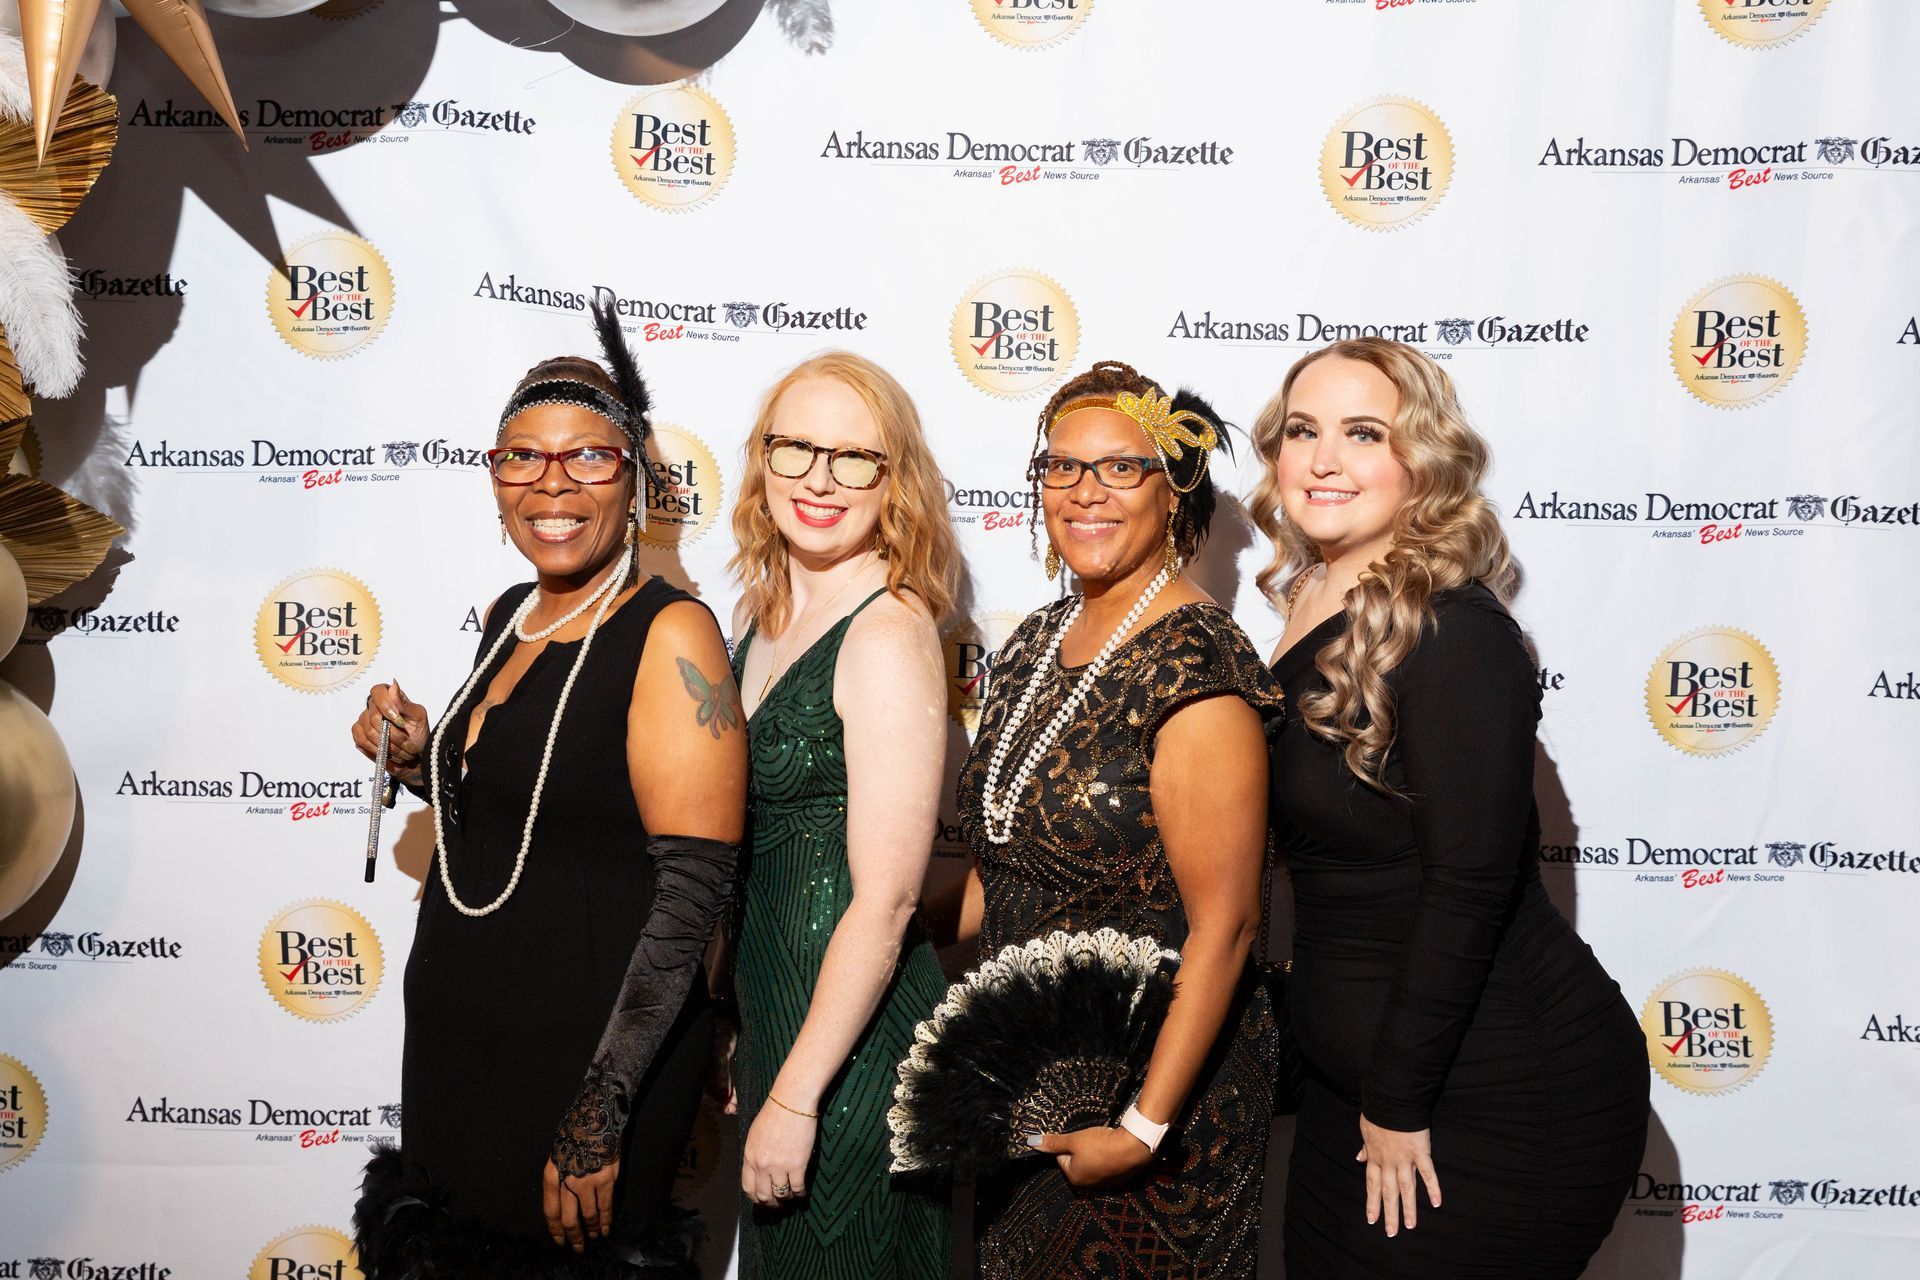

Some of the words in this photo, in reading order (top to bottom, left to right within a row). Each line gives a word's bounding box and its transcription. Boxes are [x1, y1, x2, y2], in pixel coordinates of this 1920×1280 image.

[128, 99, 249, 127] Arkanss
[256, 99, 385, 128] Democrat
[432, 99, 536, 135] Gazette
[309, 130, 350, 150] Best
[354, 135, 377, 143] News
[379, 134, 409, 142] Source
[629, 113, 711, 151] Best
[650, 147, 716, 175] Best
[820, 130, 939, 160] Arkansas
[946, 132, 1075, 162] Democrat
[1123, 136, 1234, 168] Gazette
[1339, 131, 1428, 168] Best
[1538, 137, 1663, 167] Arkansas
[1671, 138, 1808, 166] Democrat
[999, 165, 1041, 185] Best
[1043, 171, 1067, 180] News
[1069, 171, 1099, 180] Source
[1362, 164, 1432, 191] Best
[1727, 167, 1771, 190] Best
[1774, 172, 1798, 181] News
[1801, 171, 1833, 180] Source
[80, 269, 188, 299] Gazette
[285, 265, 369, 301] Best
[309, 297, 375, 321] Best
[473, 271, 585, 311] Arkansas
[592, 285, 716, 324] Democrat
[762, 302, 868, 332] Gazette
[643, 322, 684, 342] Best
[686, 331, 709, 340] News
[711, 333, 740, 342] Source
[969, 301, 1054, 338] Best
[1167, 311, 1289, 341] Arkansas
[1477, 316, 1590, 347] Gazette
[1690, 310, 1780, 348] Best
[991, 335, 1059, 361] Best
[1713, 343, 1784, 368] Best
[124, 440, 244, 467] Arkansas
[251, 440, 375, 466] Democrat
[302, 469, 342, 489] Best
[345, 474, 368, 482] News
[371, 473, 400, 481] Source
[1513, 491, 1637, 521] Arkansas
[1645, 493, 1778, 521] Democrat
[983, 511, 1023, 530] Best
[1699, 523, 1742, 544] Best
[1745, 528, 1769, 537] News
[1773, 528, 1804, 536] Source
[71, 606, 180, 636] Gazette
[273, 602, 357, 637] Best
[296, 632, 362, 656] Best
[1665, 661, 1753, 697] Best
[1688, 693, 1758, 717] Best
[116, 771, 232, 797] Arkansas
[239, 772, 362, 799] Democrat
[290, 802, 330, 821] Best
[333, 807, 355, 815] News
[1626, 838, 1758, 866] Democrat
[1682, 869, 1723, 888] Best
[1727, 874, 1750, 882] News
[1754, 874, 1784, 882] Source
[78, 932, 182, 961] Gazette
[275, 931, 358, 965] Best
[28, 962, 57, 970] Source
[301, 961, 366, 985] Best
[1658, 1001, 1747, 1037] Best
[1685, 1033, 1754, 1057] Best
[126, 1096, 241, 1125] Arkansas
[248, 1100, 371, 1126] Democrat
[299, 1129, 340, 1148] Best
[1629, 1173, 1761, 1202] Democrat
[1680, 1205, 1724, 1223] Best
[1726, 1211, 1750, 1219] News
[1753, 1211, 1783, 1219] Source
[67, 1258, 171, 1280] Gazette
